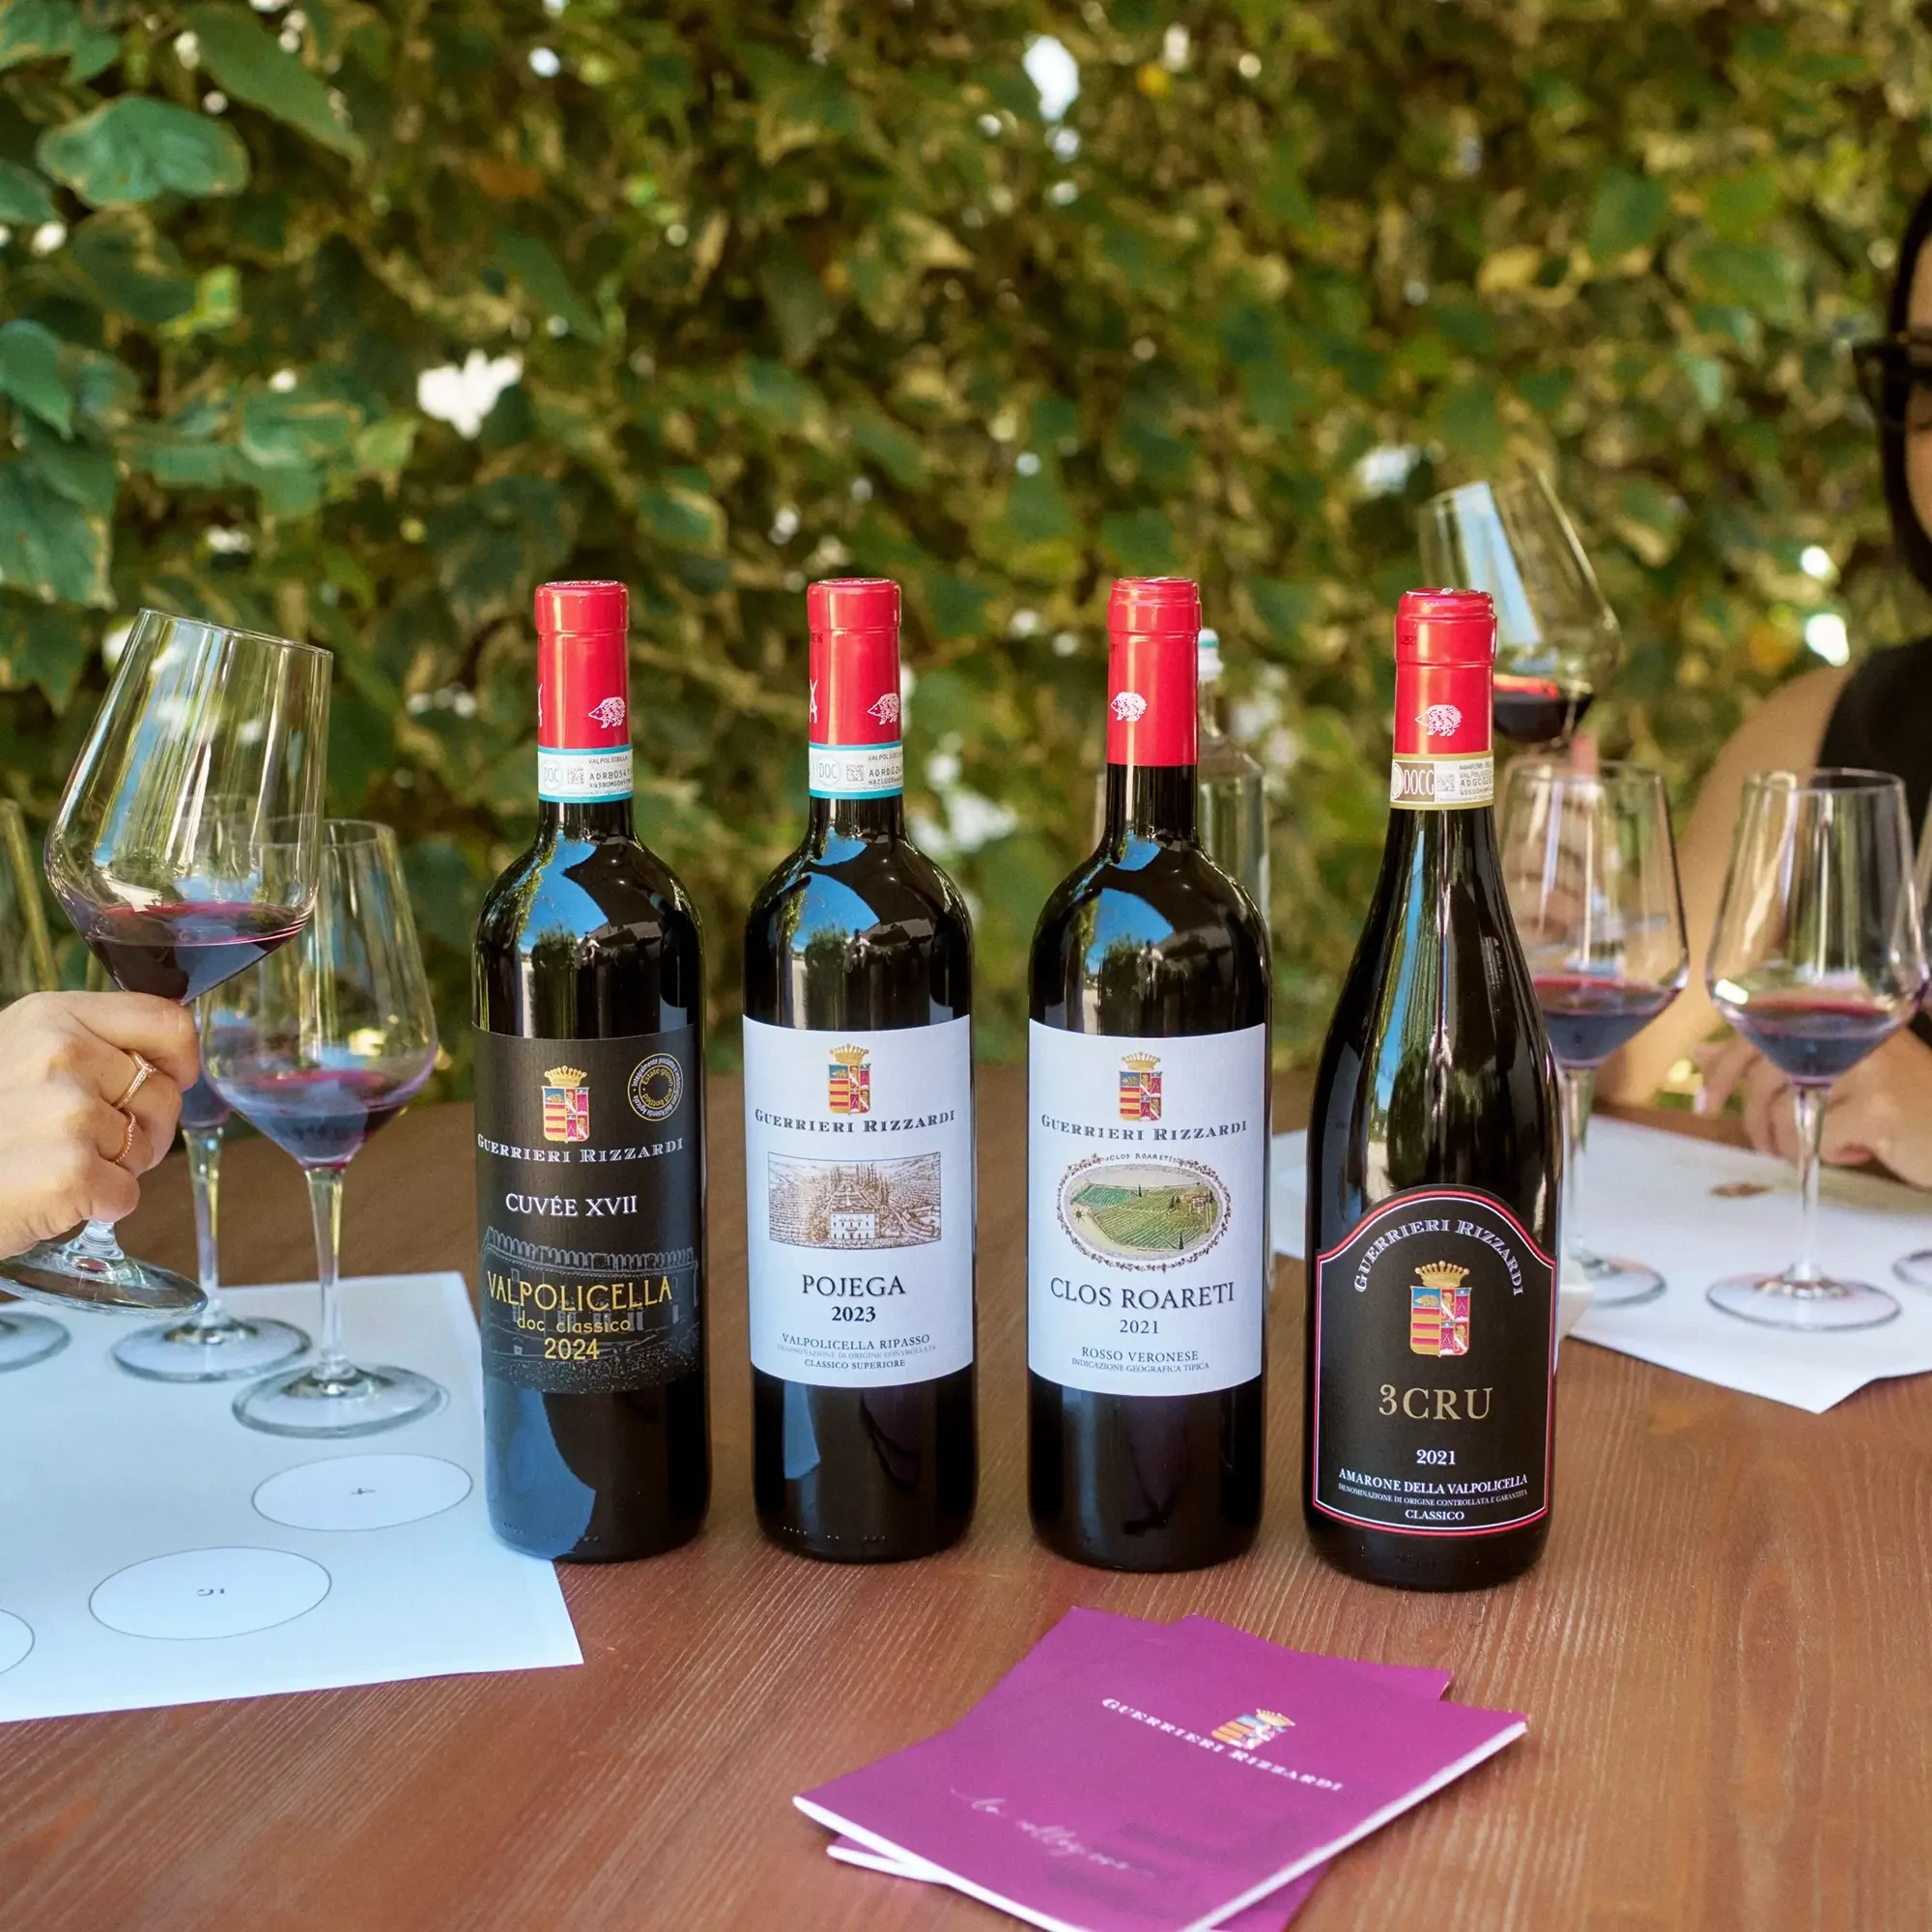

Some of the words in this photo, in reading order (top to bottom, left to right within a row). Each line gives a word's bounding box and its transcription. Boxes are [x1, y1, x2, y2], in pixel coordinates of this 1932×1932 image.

[819, 762, 838, 779] DOC
[1404, 769, 1434, 795] DOCG
[641, 1069, 659, 1085] Estate
[660, 1068, 673, 1086] grown
[641, 1094, 665, 1106] bottled
[664, 1087, 672, 1102] and
[754, 1108, 855, 1133] GUERRIERI
[863, 1109, 955, 1133] RIZZARDI
[1041, 1114, 1144, 1141] GUERRIERI
[1153, 1121, 1247, 1141] RIZZARDI
[477, 1133, 571, 1163] GUERRIERI
[579, 1137, 684, 1163] RIZZARDI
[1135, 1152, 1173, 1162] ROARETI
[505, 1193, 579, 1216] CUVÉE
[585, 1195, 639, 1216] XVII
[1353, 1219, 1450, 1293] GUERRIERI
[1455, 1219, 1523, 1296] RIZZARDI
[487, 1270, 673, 1312] VALPOLICELLA
[802, 1274, 906, 1297] POJEGA
[1050, 1277, 1112, 1307] CLOS
[1122, 1281, 1235, 1309] ROARETI
[517, 1312, 545, 1331] doc
[555, 1317, 631, 1334] classico
[831, 1306, 876, 1322] 2023
[1119, 1319, 1159, 1334] 2021
[544, 1338, 600, 1360] 2024
[781, 1333, 874, 1350] VALPOLICELLA
[879, 1333, 930, 1350] RIPASSO
[804, 1358, 849, 1370] CLASSICO
[851, 1359, 906, 1370] SUPERIORE
[1071, 1357, 1124, 1372] INDICAZIONE
[1126, 1363, 1181, 1373] GEOGRAFICA
[1183, 1362, 1209, 1372] TIPICA
[1082, 1346, 1123, 1361] ROSSO
[1127, 1350, 1199, 1363] VERONESE
[1378, 1383, 1493, 1421] 3CRU
[1416, 1449, 1456, 1465] 2021
[1339, 1468, 1402, 1492] AMARONE
[1404, 1481, 1445, 1494] DELLA
[1446, 1473, 1528, 1494] VALPOLICELLA
[1338, 1483, 1392, 1502] DENOMINAZIONE
[1394, 1495, 1403, 1504] DI
[1404, 1497, 1435, 1506] ORIGINE
[1435, 1497, 1490, 1506] CONTROLLATA
[1495, 1490, 1528, 1502] GARANTITA
[1405, 1509, 1464, 1520] CLASSICO
[1101, 1698, 1225, 1752] GUERRIERI
[1228, 1748, 1344, 1791] RIZZARDI
